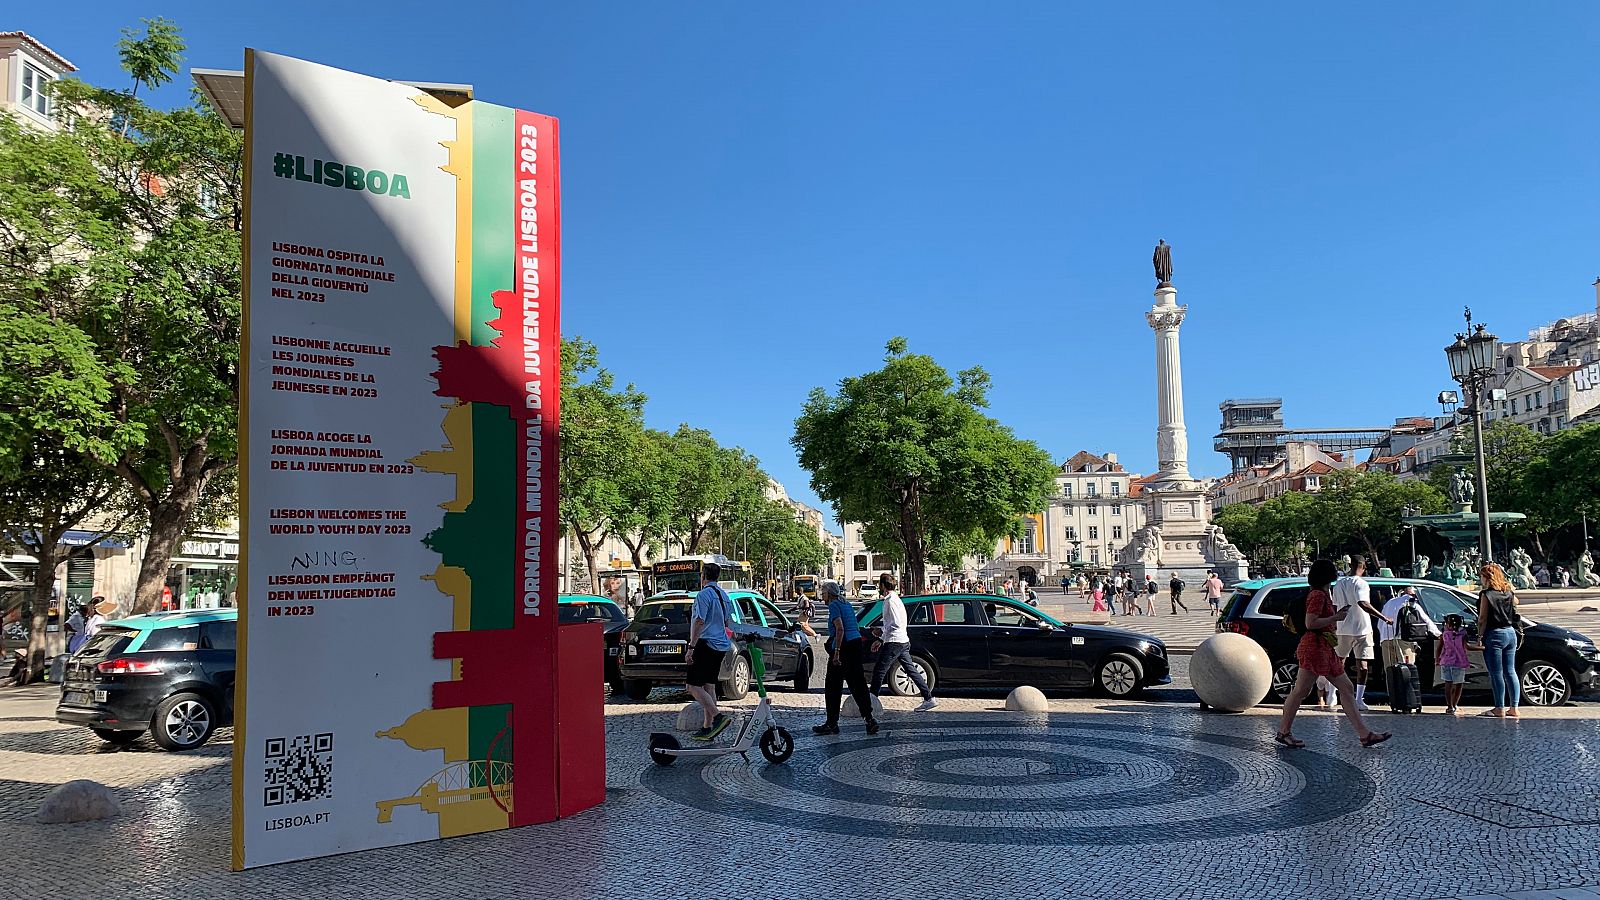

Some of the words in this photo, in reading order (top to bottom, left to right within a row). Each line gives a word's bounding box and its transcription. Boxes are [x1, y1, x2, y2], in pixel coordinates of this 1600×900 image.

[520, 124, 538, 175] 2023
[273, 152, 411, 199] #LISBOA
[520, 179, 538, 253] LISBOA
[272, 241, 324, 258] LISBONA
[326, 249, 368, 264] OSPITA
[370, 255, 385, 267] LA
[272, 257, 333, 274] GIORNATA
[335, 265, 395, 282] MONDIALE
[271, 272, 309, 286] DELLA
[311, 278, 369, 293] GIOVENTÙ
[271, 287, 294, 299] NEL
[297, 290, 326, 303] 2023
[522, 256, 541, 375] JUVENTUDE
[272, 335, 331, 351] LISBONNE
[333, 341, 391, 356] ACCUEILLE
[272, 350, 294, 362] LES
[296, 352, 355, 367] JOURNÉES
[272, 365, 342, 381] MONDIALES
[343, 372, 358, 382] DE
[360, 373, 375, 383] LA
[271, 380, 330, 395] JEUNESSE
[332, 385, 348, 396] EN
[350, 387, 378, 398] 2023
[526, 380, 542, 410] DA
[271, 429, 315, 441] LISBOA
[316, 432, 355, 443] ACOGE
[357, 433, 372, 444] LA
[270, 444, 327, 457] JORNADA
[329, 447, 384, 459] MUNDIAL
[270, 460, 287, 471] DE
[290, 461, 305, 471] LA
[307, 461, 367, 473] JUVENTUD
[369, 463, 385, 474] EN
[387, 464, 414, 475] 2023
[526, 414, 542, 512] MUNDIAL
[270, 508, 315, 519] LISBON
[317, 509, 383, 520] WELCOMES
[384, 510, 407, 520] THE
[270, 524, 315, 535] WORLD
[317, 524, 356, 535] YOUTH
[358, 525, 382, 535] DAY
[384, 525, 411, 535] 2023
[523, 516, 541, 617] JORNADA
[268, 574, 330, 585] LISSABON
[332, 572, 396, 584] EMPFÄNGT
[268, 590, 294, 601] DEN
[297, 588, 396, 600] WELTJUGENDTAG
[267, 606, 281, 617] IN
[284, 605, 315, 616] 2023
[265, 812, 331, 831] LISBOA.PT
